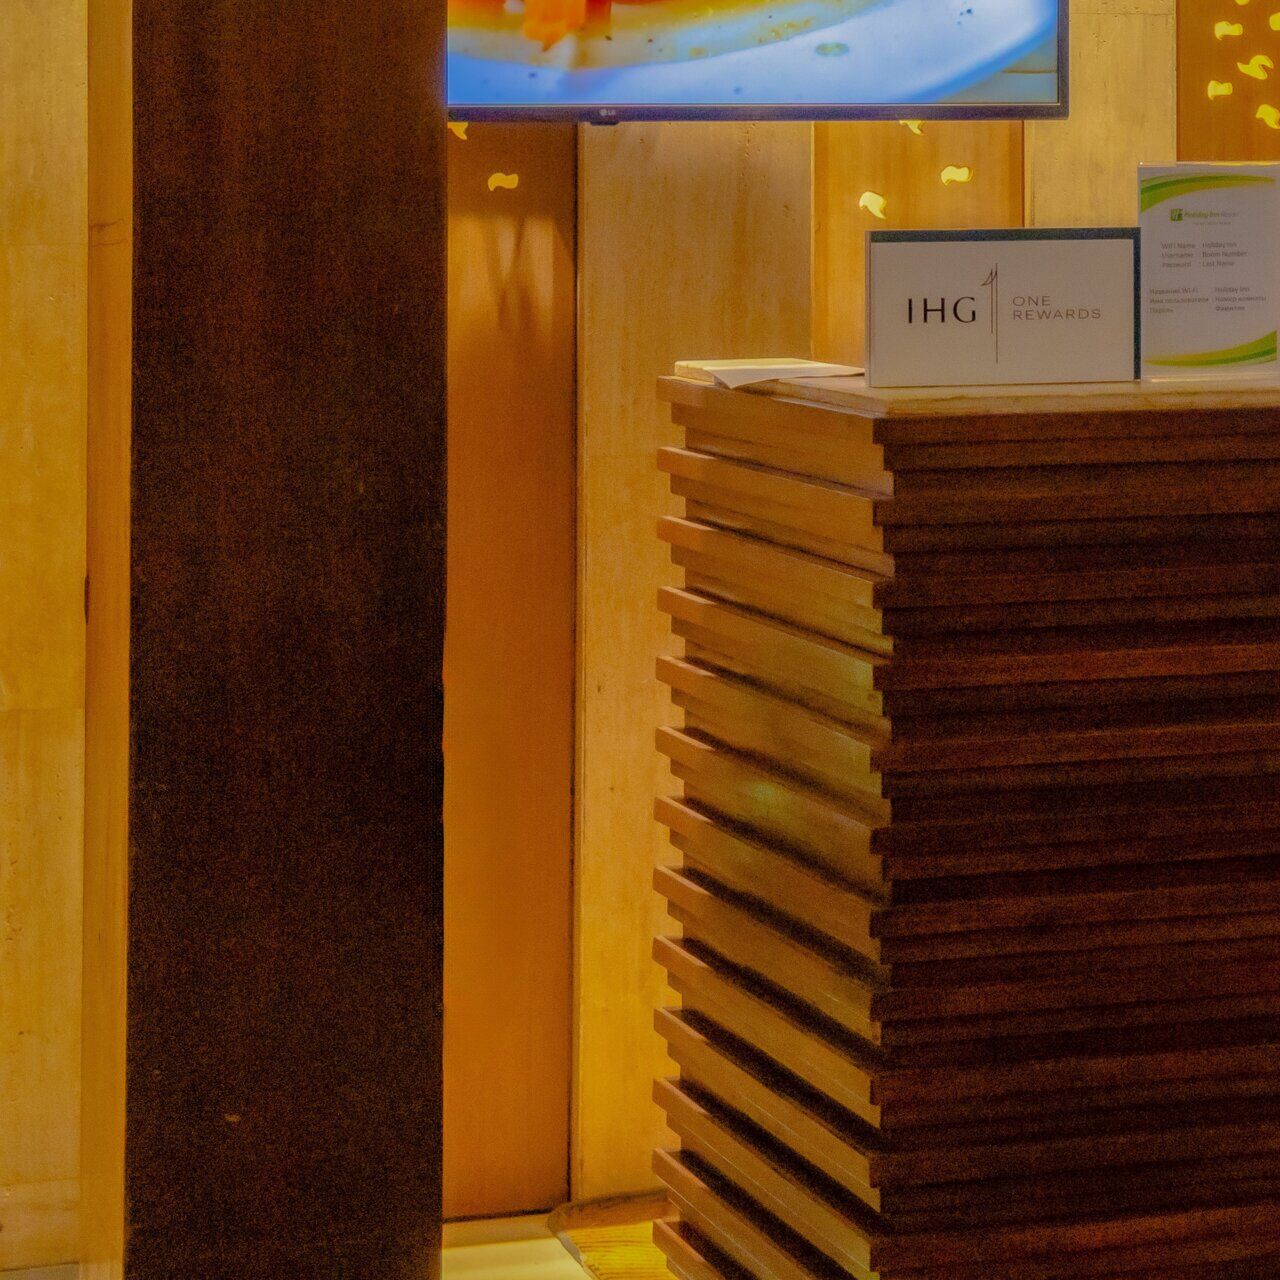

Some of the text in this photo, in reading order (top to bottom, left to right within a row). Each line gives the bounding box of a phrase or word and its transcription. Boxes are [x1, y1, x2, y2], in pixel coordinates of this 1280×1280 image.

[907, 294, 1052, 324] IHG ONE
[1012, 307, 1102, 321] REWARDS
